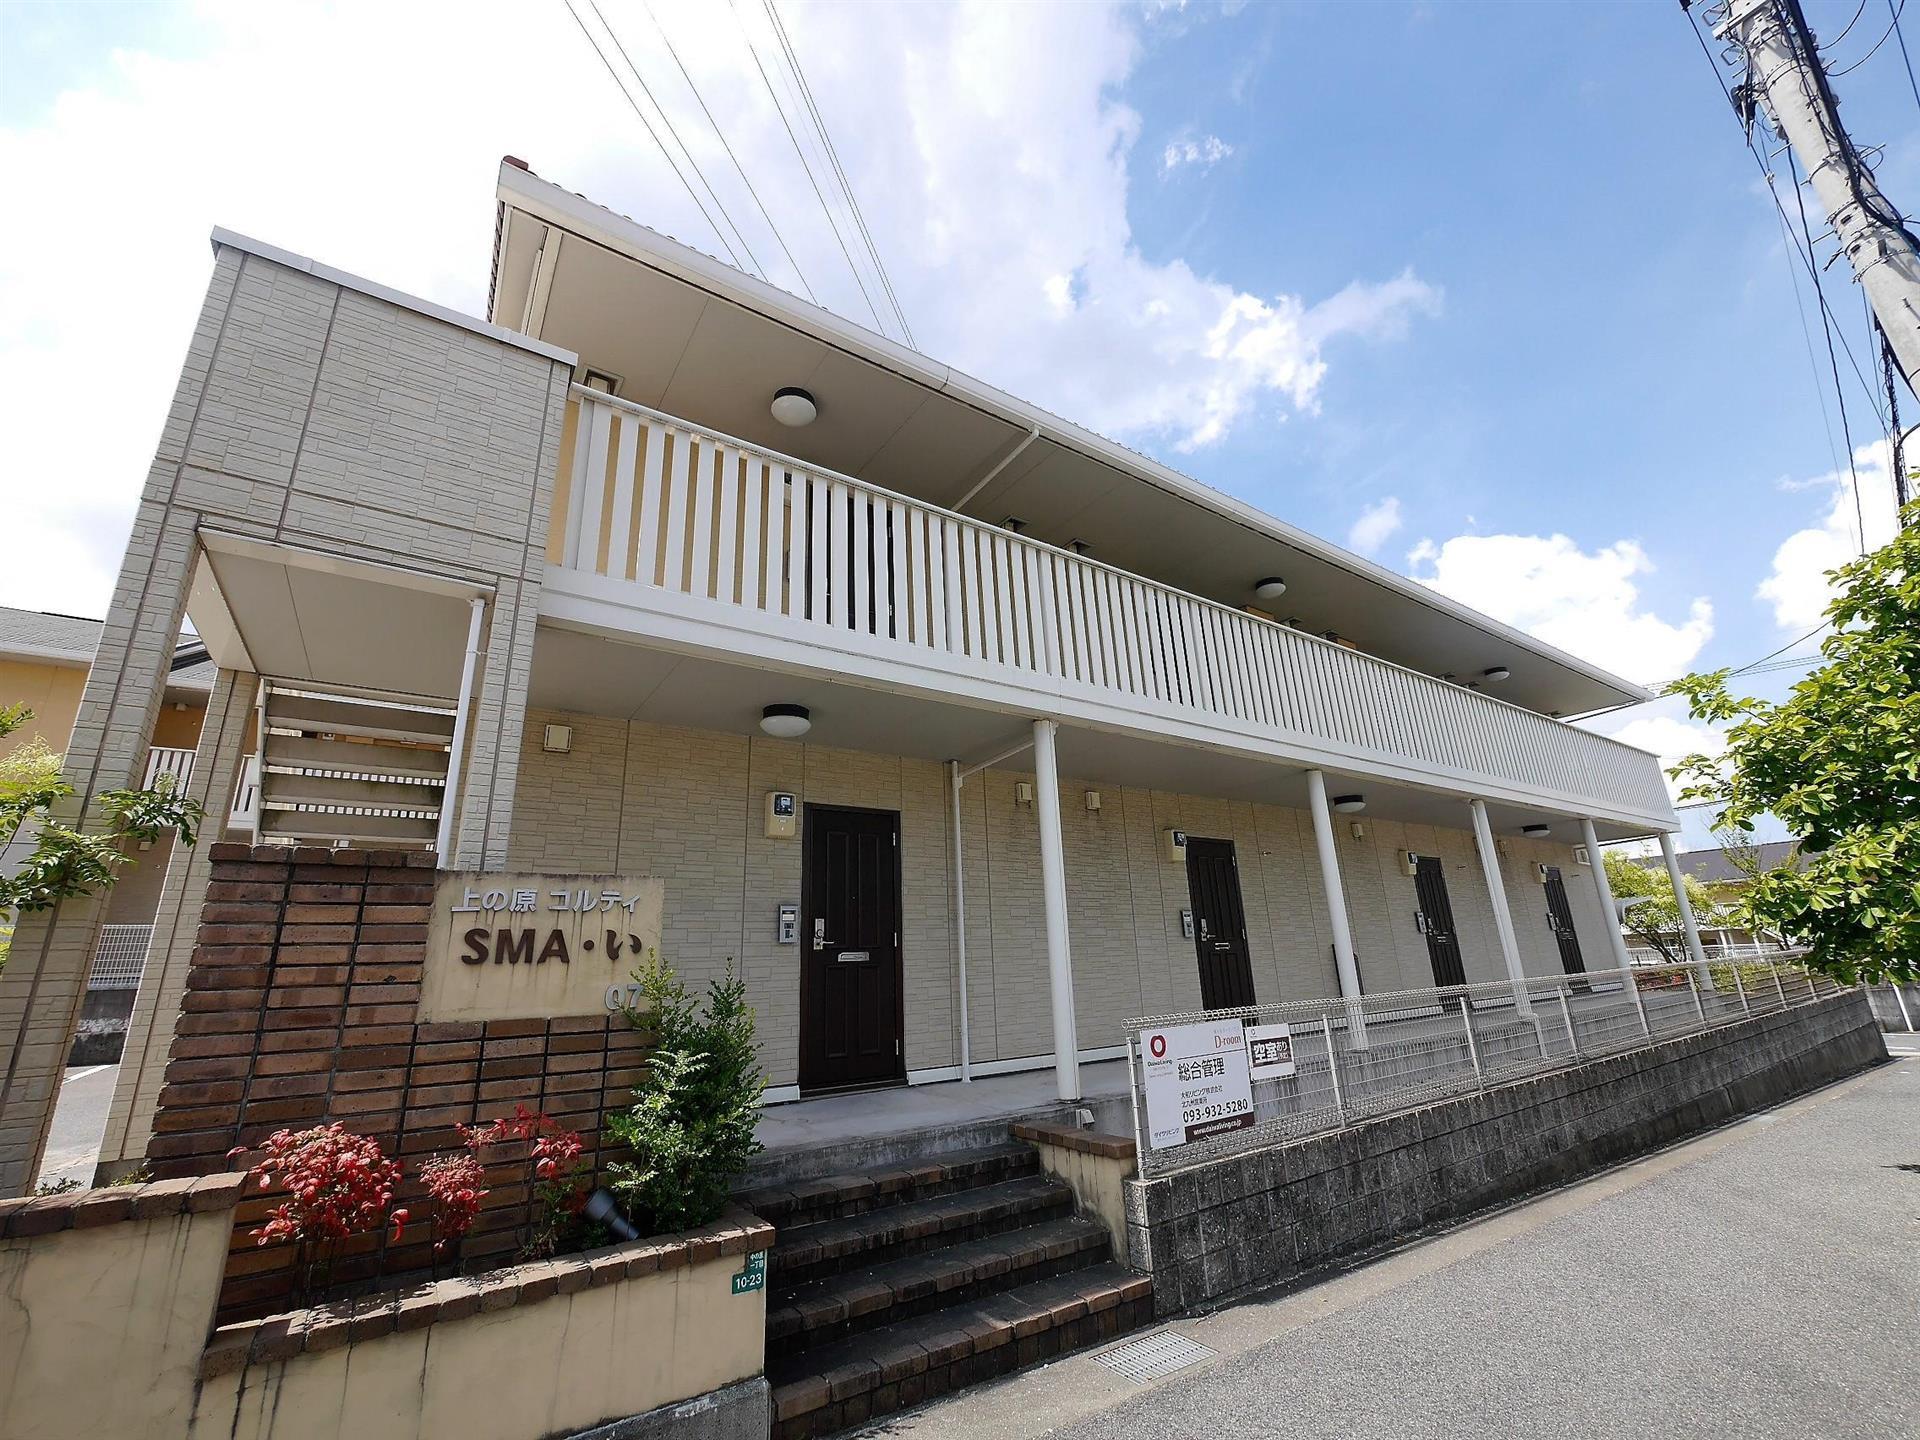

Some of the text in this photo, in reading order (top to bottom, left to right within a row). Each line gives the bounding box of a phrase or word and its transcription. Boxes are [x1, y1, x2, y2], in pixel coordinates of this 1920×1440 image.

[451, 887, 640, 912] 上の原 コルティ
[605, 984, 644, 1010] 07
[1214, 1034, 1242, 1049] D-room
[1253, 1040, 1288, 1063] 空室あり
[1177, 1057, 1225, 1082] 総合管理
[1183, 1098, 1248, 1123] 093-932-5280
[736, 1273, 762, 1290] 10-23
